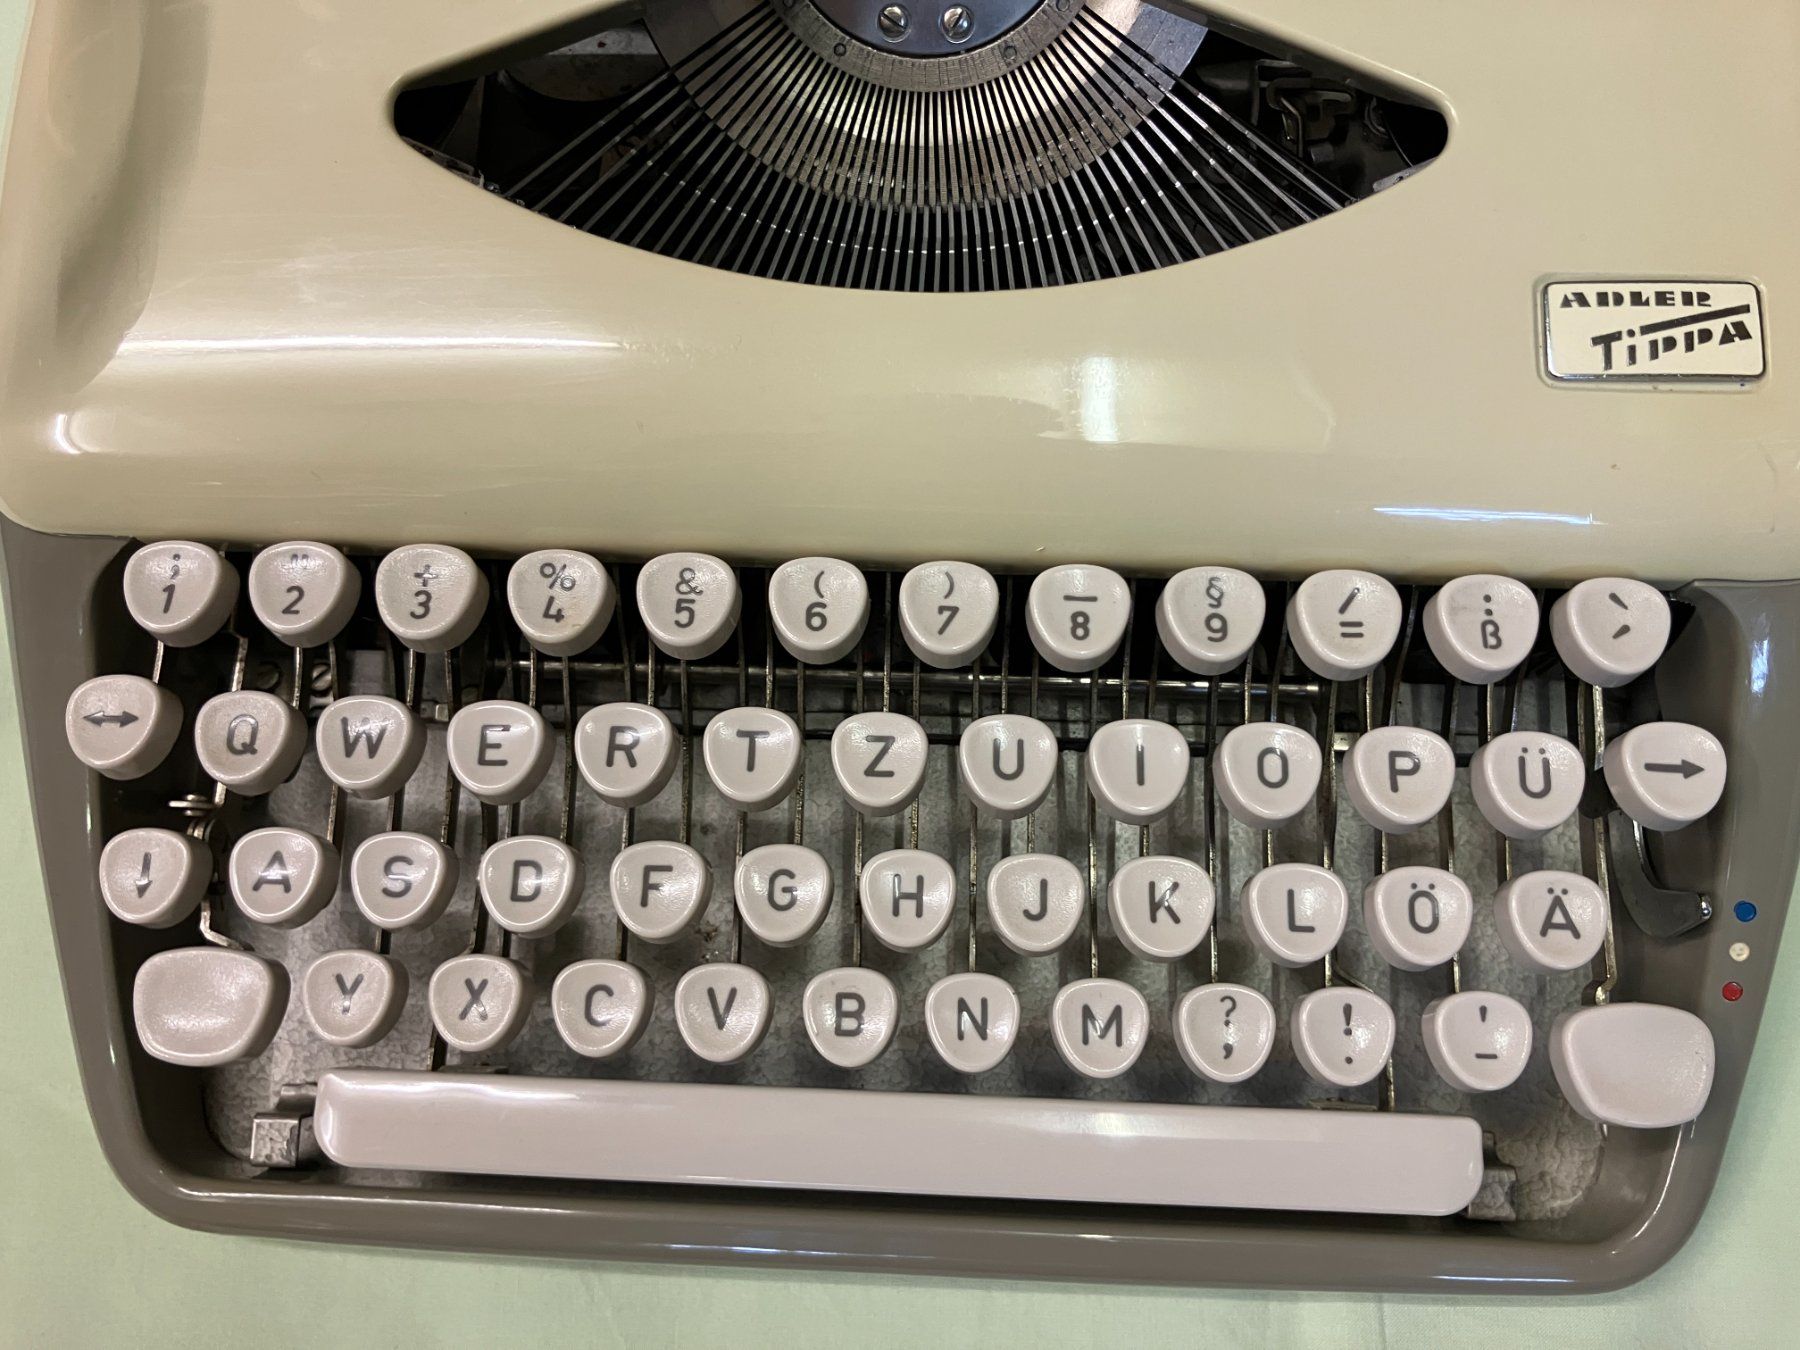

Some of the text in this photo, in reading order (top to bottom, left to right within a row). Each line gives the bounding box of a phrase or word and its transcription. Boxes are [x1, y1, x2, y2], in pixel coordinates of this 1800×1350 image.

[1560, 291, 1712, 308] ADLER
[539, 562, 576, 592] %
[675, 567, 704, 595] &
[814, 570, 825, 598] (
[943, 571, 955, 599] )
[1205, 576, 1225, 609] §
[162, 584, 175, 614] 1
[282, 585, 305, 615] 2
[409, 590, 433, 619] 3
[542, 596, 565, 623] 4
[674, 598, 696, 628] 5
[805, 601, 828, 632] 6
[938, 605, 959, 635] 7
[1338, 587, 1361, 615] /
[1483, 594, 1494, 617] :
[1070, 610, 1091, 641] 8
[1204, 612, 1228, 643] 9
[1339, 621, 1364, 638] =
[225, 714, 258, 756] Q
[340, 716, 389, 761] W
[477, 724, 512, 767] E
[605, 725, 641, 768] R
[736, 729, 770, 773] T
[863, 735, 896, 778] Z
[992, 737, 1025, 781] U
[1135, 744, 1146, 787] I
[1256, 746, 1290, 789] O
[1387, 750, 1421, 794] P
[1517, 746, 1552, 800] Ü
[252, 850, 292, 894] A
[381, 854, 414, 898] S
[509, 859, 543, 903] D
[640, 864, 674, 908] F
[767, 868, 798, 912] G
[892, 873, 924, 918] H
[1022, 878, 1049, 922] J
[1148, 880, 1182, 925] K
[1286, 888, 1316, 933] L
[1407, 882, 1440, 935] Ö
[1539, 886, 1582, 940] Ä
[335, 973, 364, 1015] Y
[459, 977, 488, 1021] X
[584, 983, 615, 1027] C
[706, 986, 738, 1031] V
[834, 992, 866, 1037] B
[1220, 995, 1237, 1027] ?
[956, 996, 989, 1042] N
[1081, 1003, 1124, 1048] M
[1342, 1002, 1353, 1037] !
